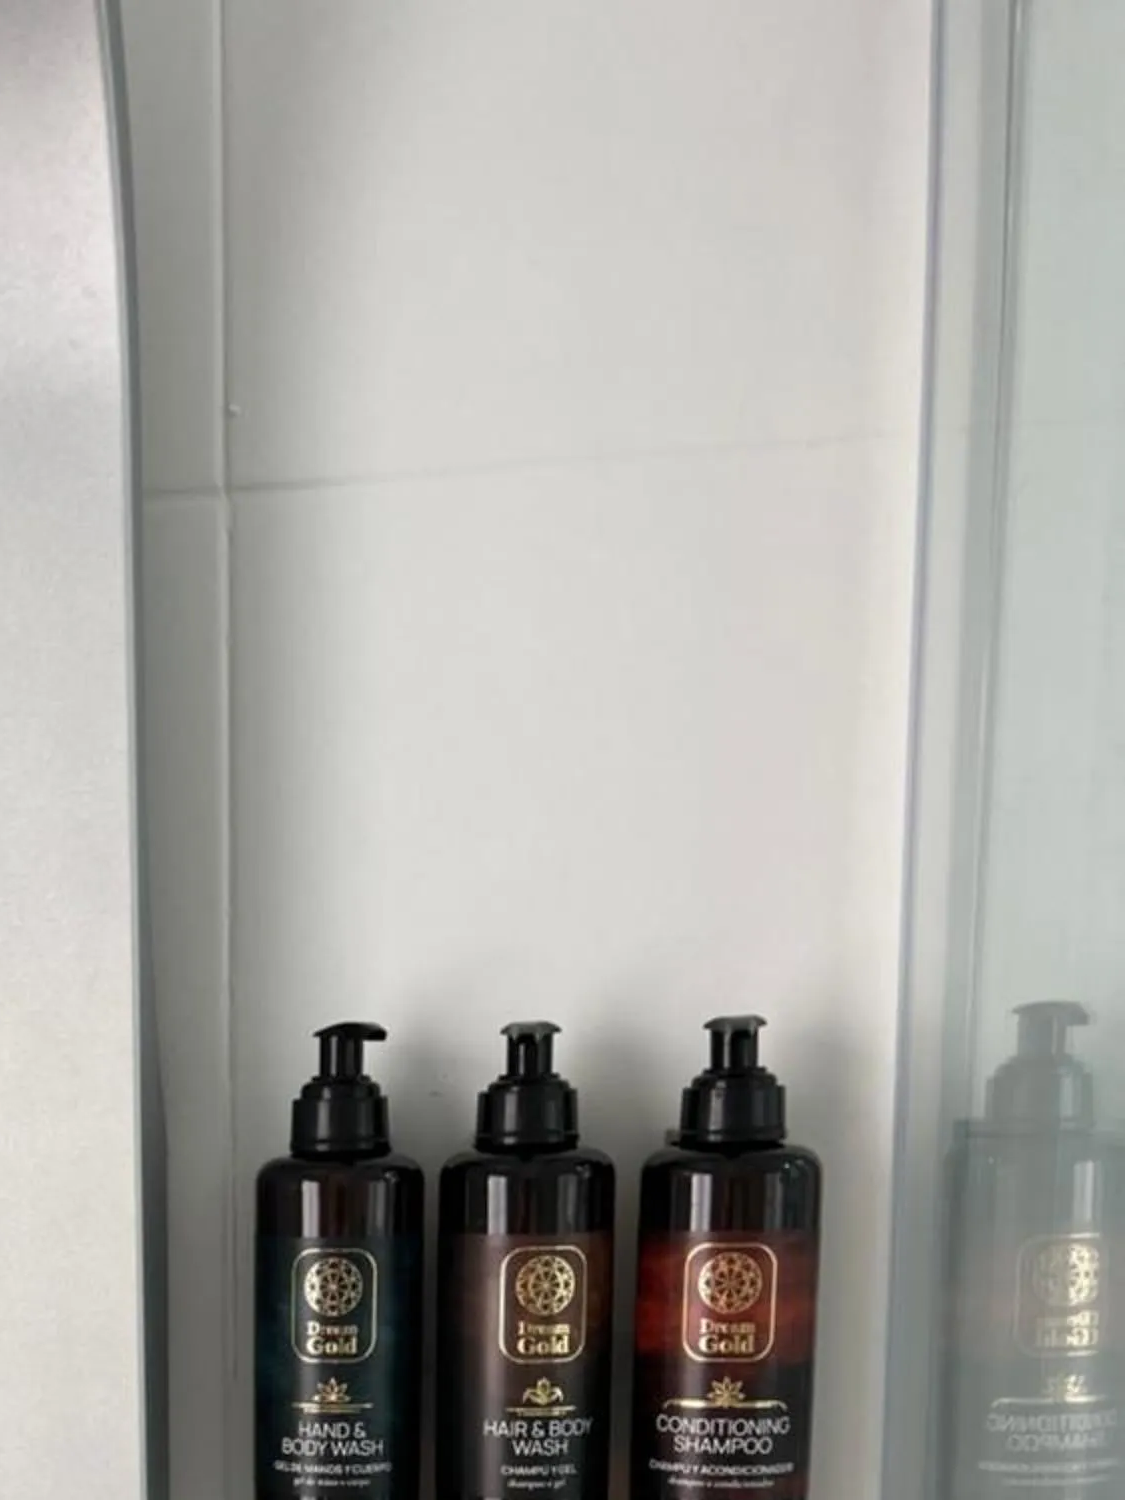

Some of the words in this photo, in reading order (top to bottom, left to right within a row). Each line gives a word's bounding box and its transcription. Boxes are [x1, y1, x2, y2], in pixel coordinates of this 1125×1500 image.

[306, 1335, 358, 1355] Gold
[516, 1334, 570, 1355] Gold
[698, 1334, 755, 1353] Gold
[298, 1420, 350, 1439] HAND
[353, 1421, 367, 1439] &
[482, 1418, 527, 1438] HAIR
[531, 1420, 545, 1438] &
[548, 1416, 593, 1437] BODY
[656, 1413, 791, 1437] CONDITIONING
[281, 1437, 327, 1456] BODY
[329, 1439, 384, 1456] WASH
[512, 1439, 569, 1456] WASH
[674, 1434, 773, 1455] SHAMPOO
